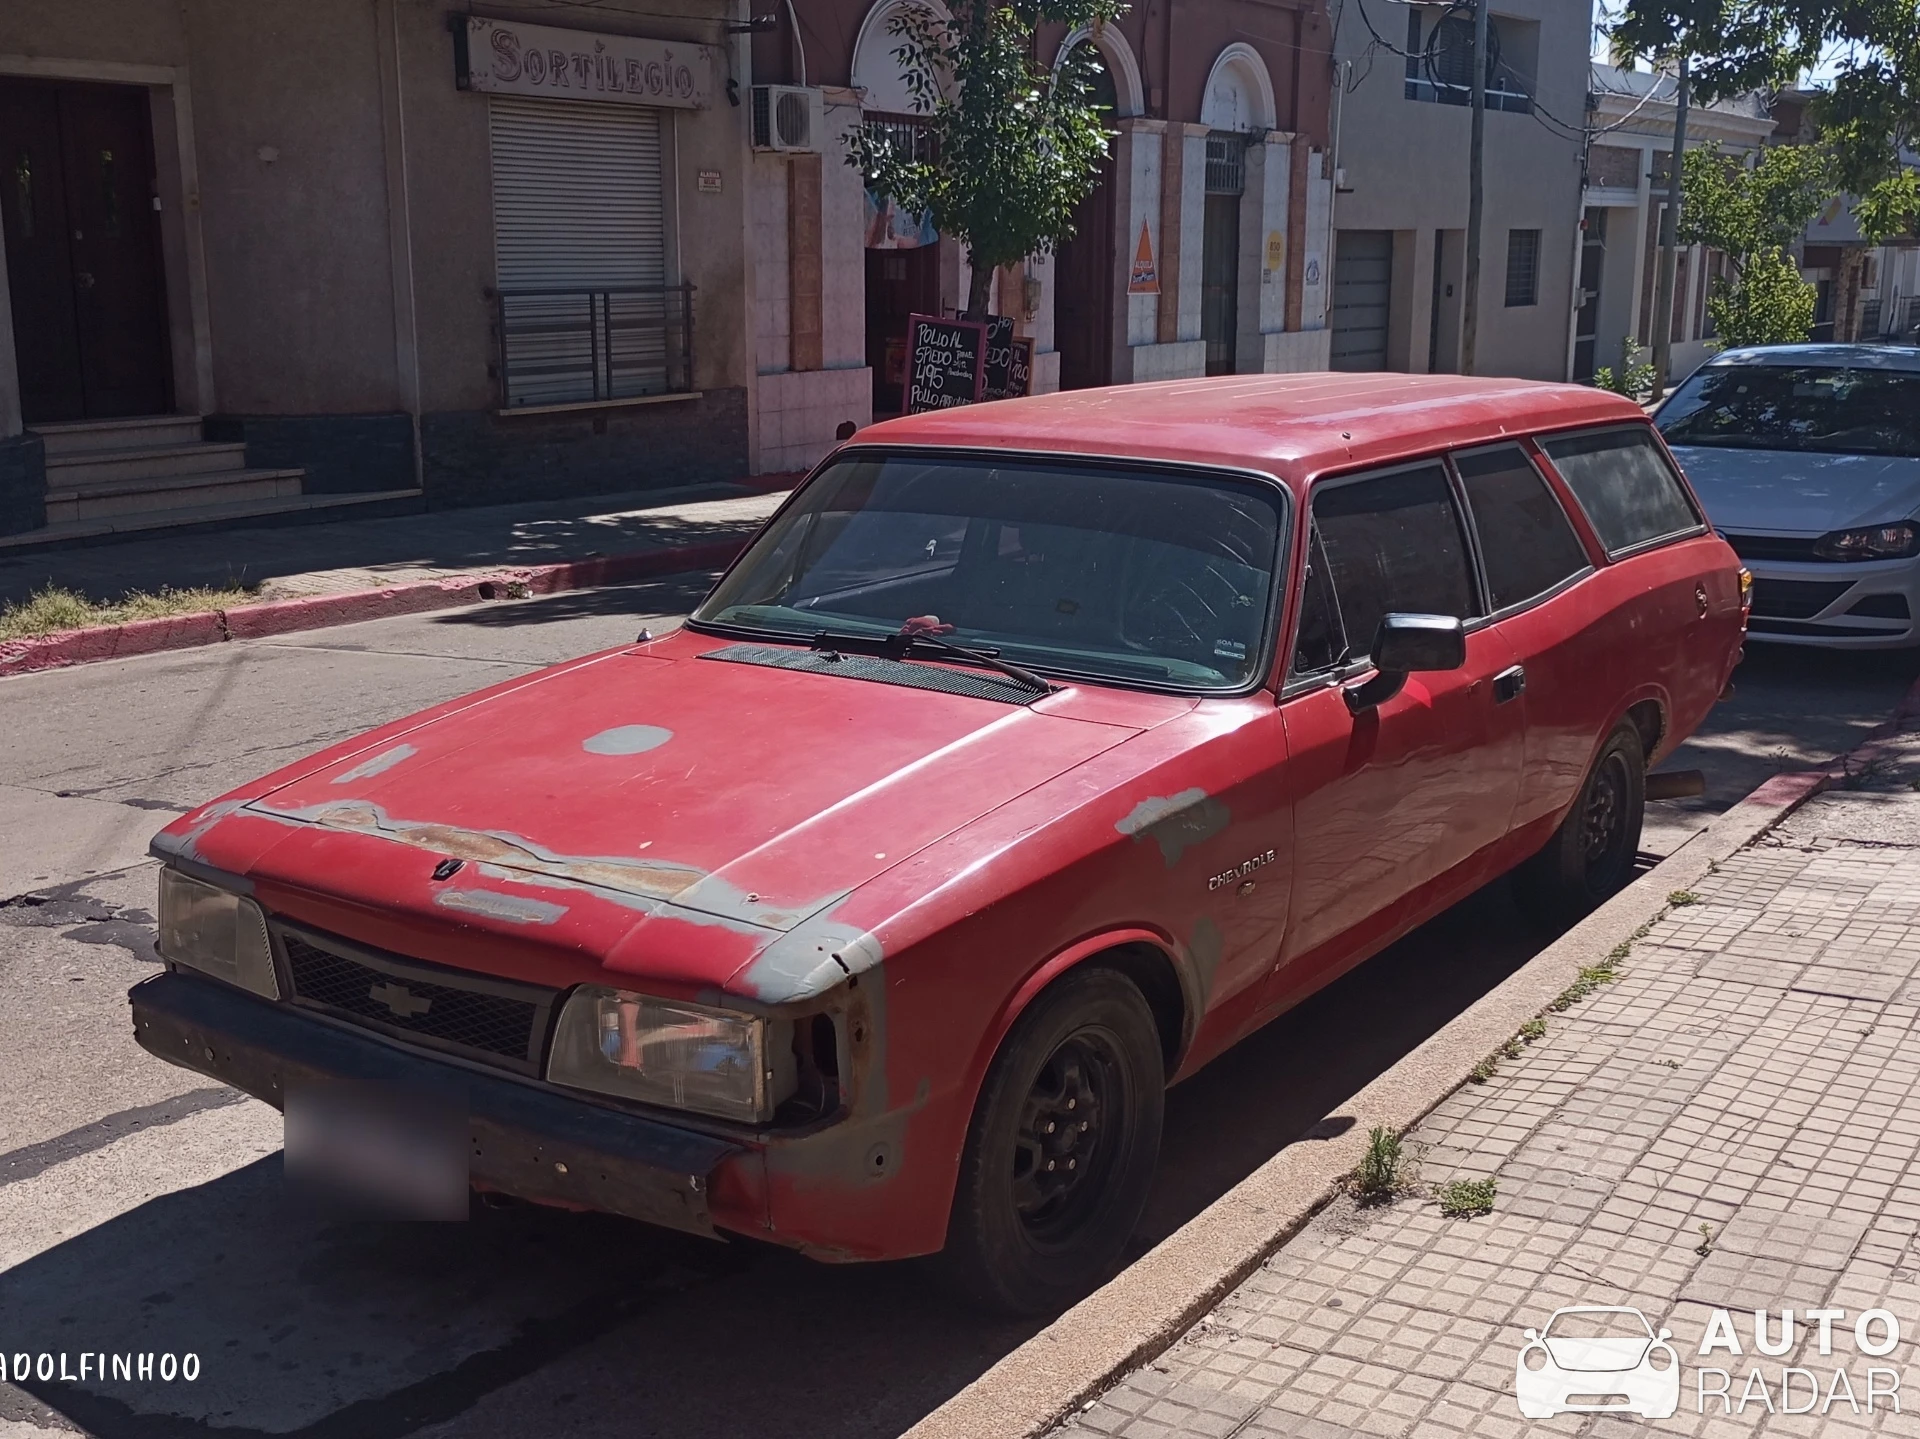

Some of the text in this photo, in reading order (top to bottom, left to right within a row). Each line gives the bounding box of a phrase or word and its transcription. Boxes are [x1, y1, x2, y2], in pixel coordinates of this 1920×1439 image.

[491, 28, 695, 98] SORTILEGIO
[918, 324, 949, 347] POLLO
[949, 331, 963, 348] AL
[915, 348, 952, 366] SPIEDO
[916, 364, 944, 390] 495
[1208, 849, 1275, 891] CHEVROLE
